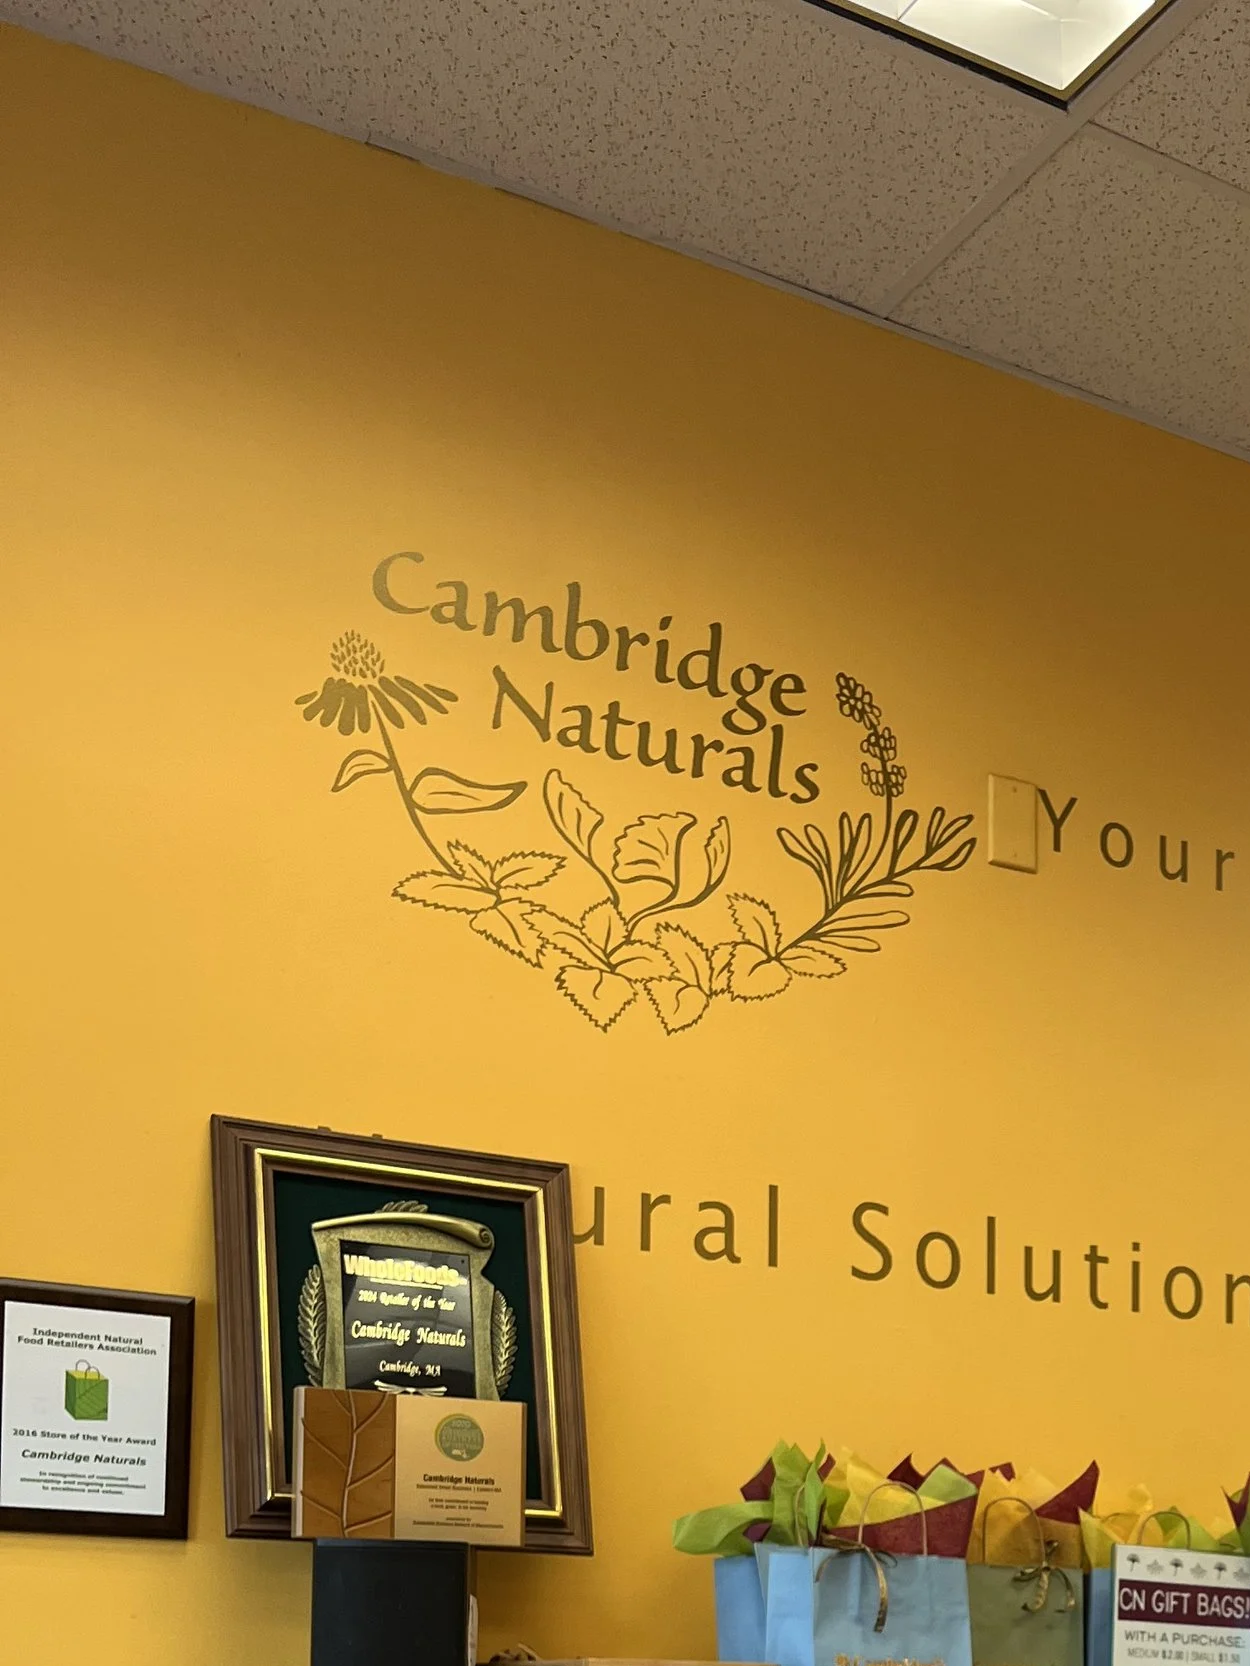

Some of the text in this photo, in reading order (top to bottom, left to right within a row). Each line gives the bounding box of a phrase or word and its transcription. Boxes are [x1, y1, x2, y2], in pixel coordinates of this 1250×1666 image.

[372, 551, 808, 735] Cambridge
[491, 665, 821, 804] Naturals
[1037, 788, 1236, 893] Your
[573, 1184, 779, 1268] ural
[32, 1327, 144, 1346] Independent Natural
[351, 1320, 467, 1348] Cambridge Naturals
[17, 1335, 157, 1356] Food Retailers Association
[379, 1360, 422, 1377] Cambridge,
[12, 1428, 157, 1446] 2016 Store of the Year Award
[21, 1449, 147, 1467] Cambridge Naturals
[423, 1473, 495, 1486] Cambridge Naturals
[1119, 1587, 1250, 1619] CN GIFT BAGS!
[1124, 1629, 1246, 1649] WITH A PURCHASE:
[1127, 1647, 1160, 1659] MEDIUM
[1191, 1650, 1215, 1663] SMALL
